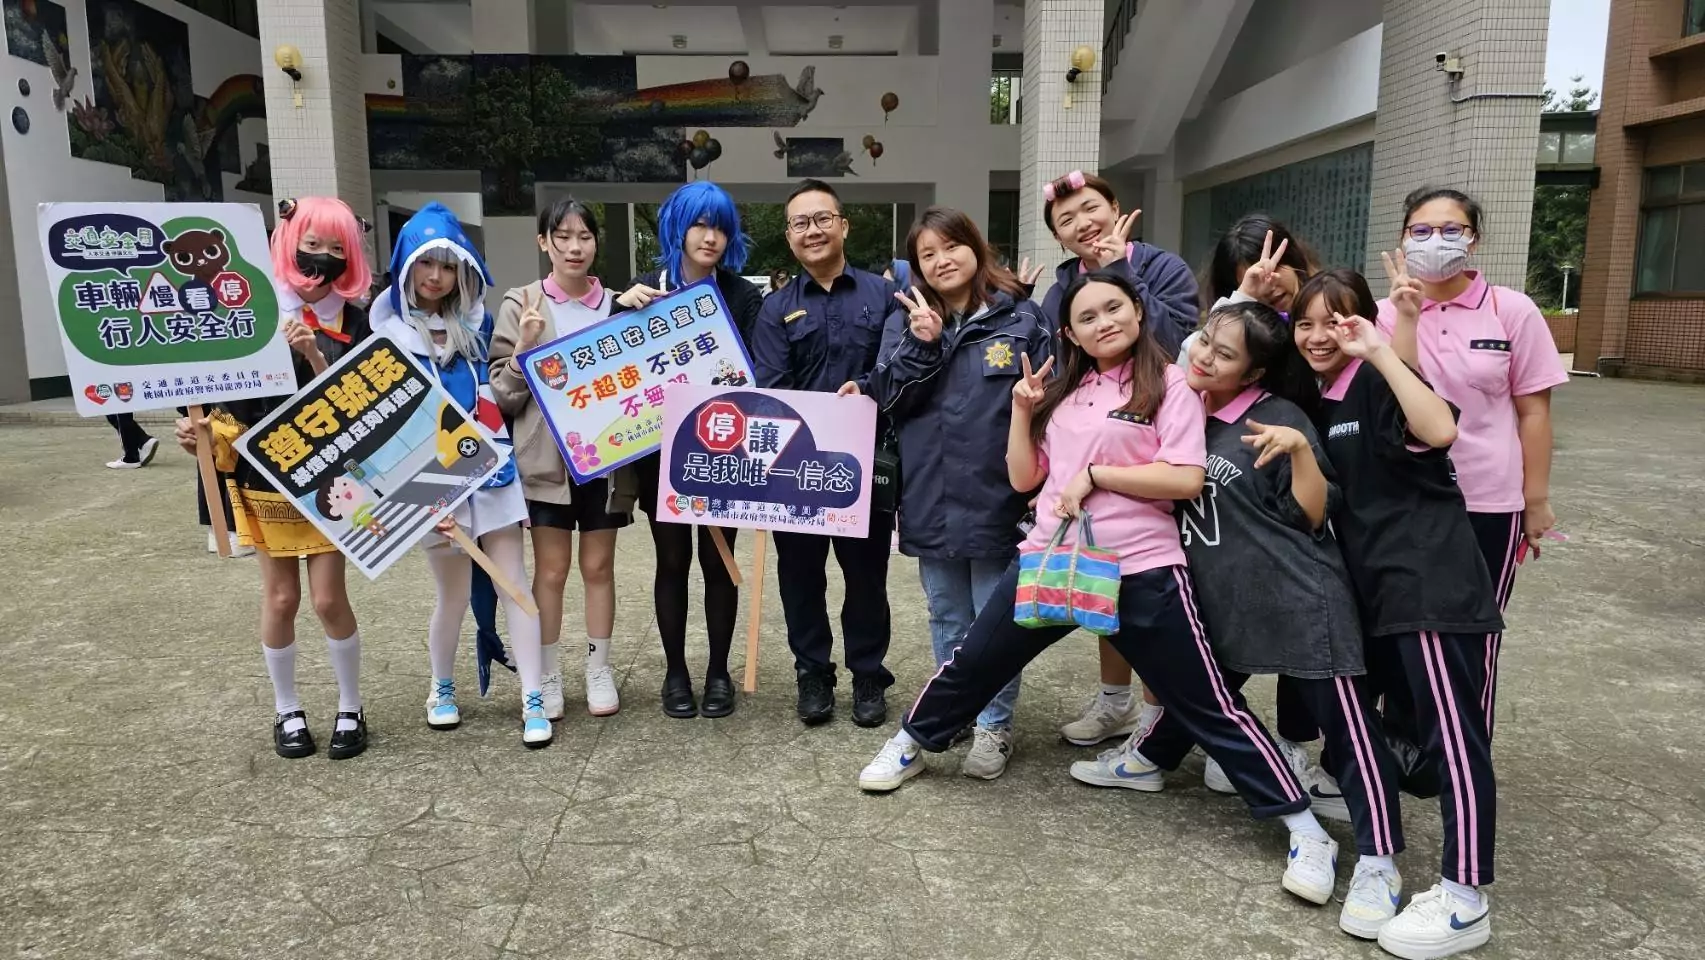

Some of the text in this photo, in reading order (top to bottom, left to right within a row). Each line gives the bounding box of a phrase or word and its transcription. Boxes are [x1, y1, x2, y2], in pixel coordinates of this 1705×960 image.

[99, 310, 256, 350] 行人安全行
[571, 294, 718, 370] 交通安全宣導
[142, 370, 259, 389] 交通部道安委員會
[143, 380, 262, 400] 桃園市政府警察局龍潭分局
[566, 331, 720, 410] 不超速 不逼車
[258, 347, 408, 472] 遵守號誌
[290, 376, 425, 488] 綠燈秒數足夠再通過
[683, 453, 855, 493] 是我唯一信念
[873, 474, 889, 485] RO
[1205, 454, 1243, 486] AVY
[1181, 482, 1220, 547] N
